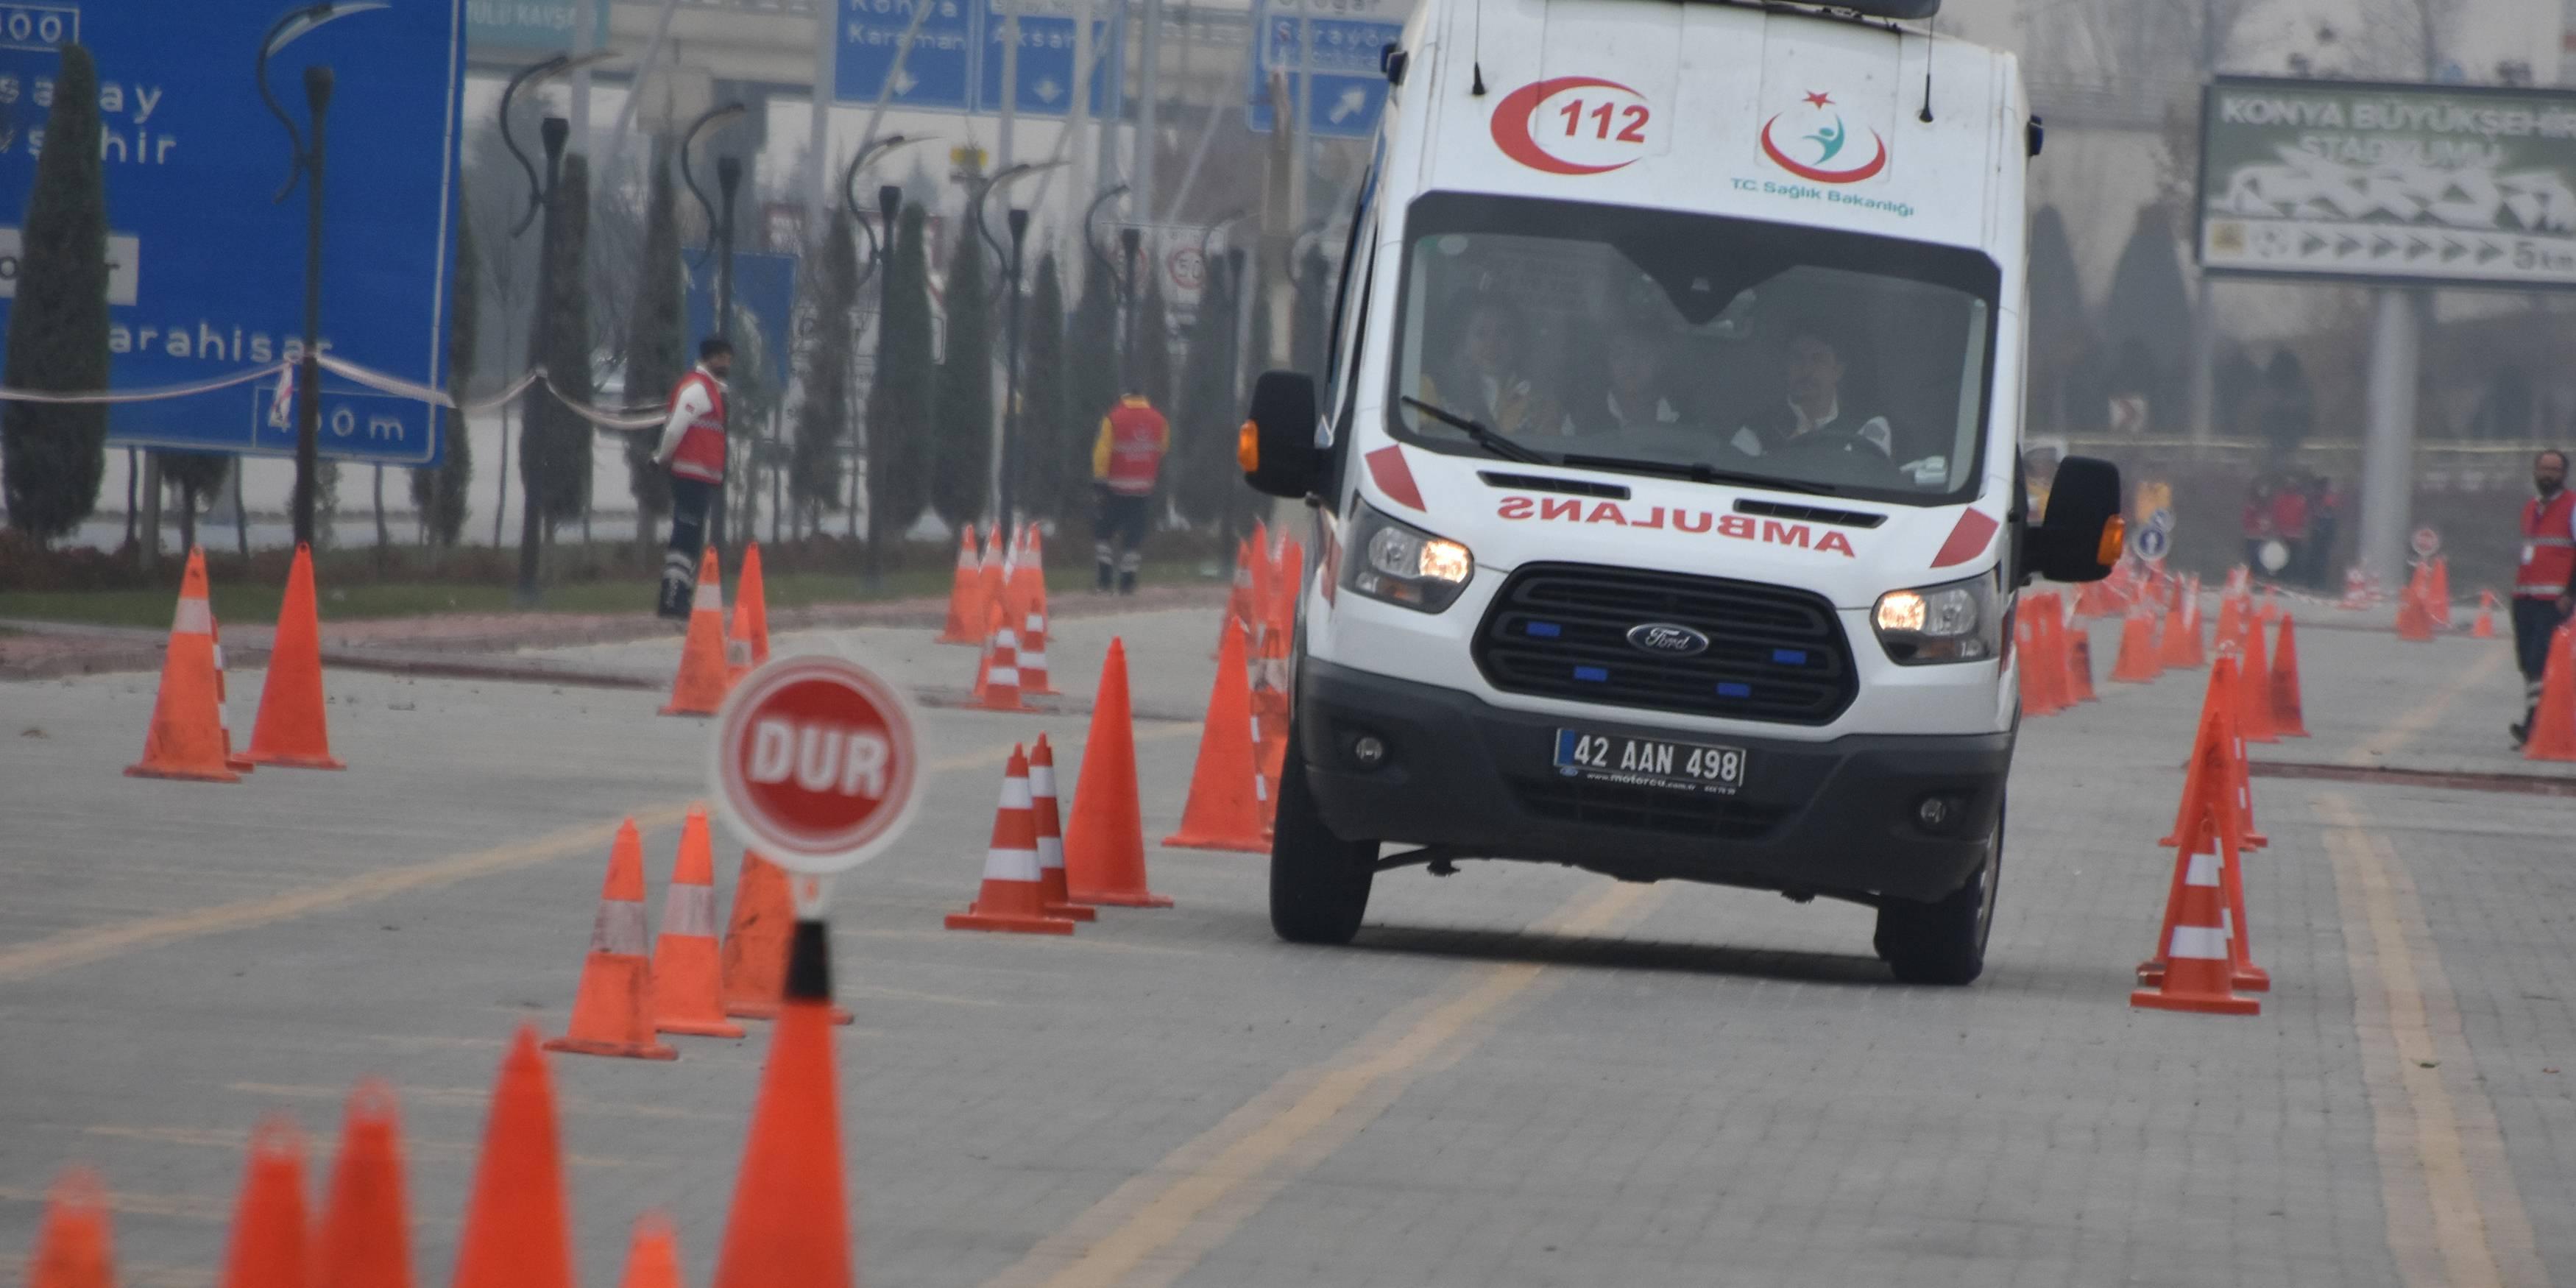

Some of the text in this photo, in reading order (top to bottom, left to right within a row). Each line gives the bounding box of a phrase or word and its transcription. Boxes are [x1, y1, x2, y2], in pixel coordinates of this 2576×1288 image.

[851, 0, 958, 18] Kona
[0, 13, 62, 43] 00
[1560, 99, 1649, 144] 112
[2221, 96, 2343, 128] KONYA
[1764, 180, 1821, 199] Sağlık
[1827, 190, 1914, 217] Bakanlığı
[370, 415, 404, 442] m
[1645, 627, 1691, 650] Ford
[750, 718, 889, 801] DUR
[1574, 735, 1738, 782] 42 AAN 498
